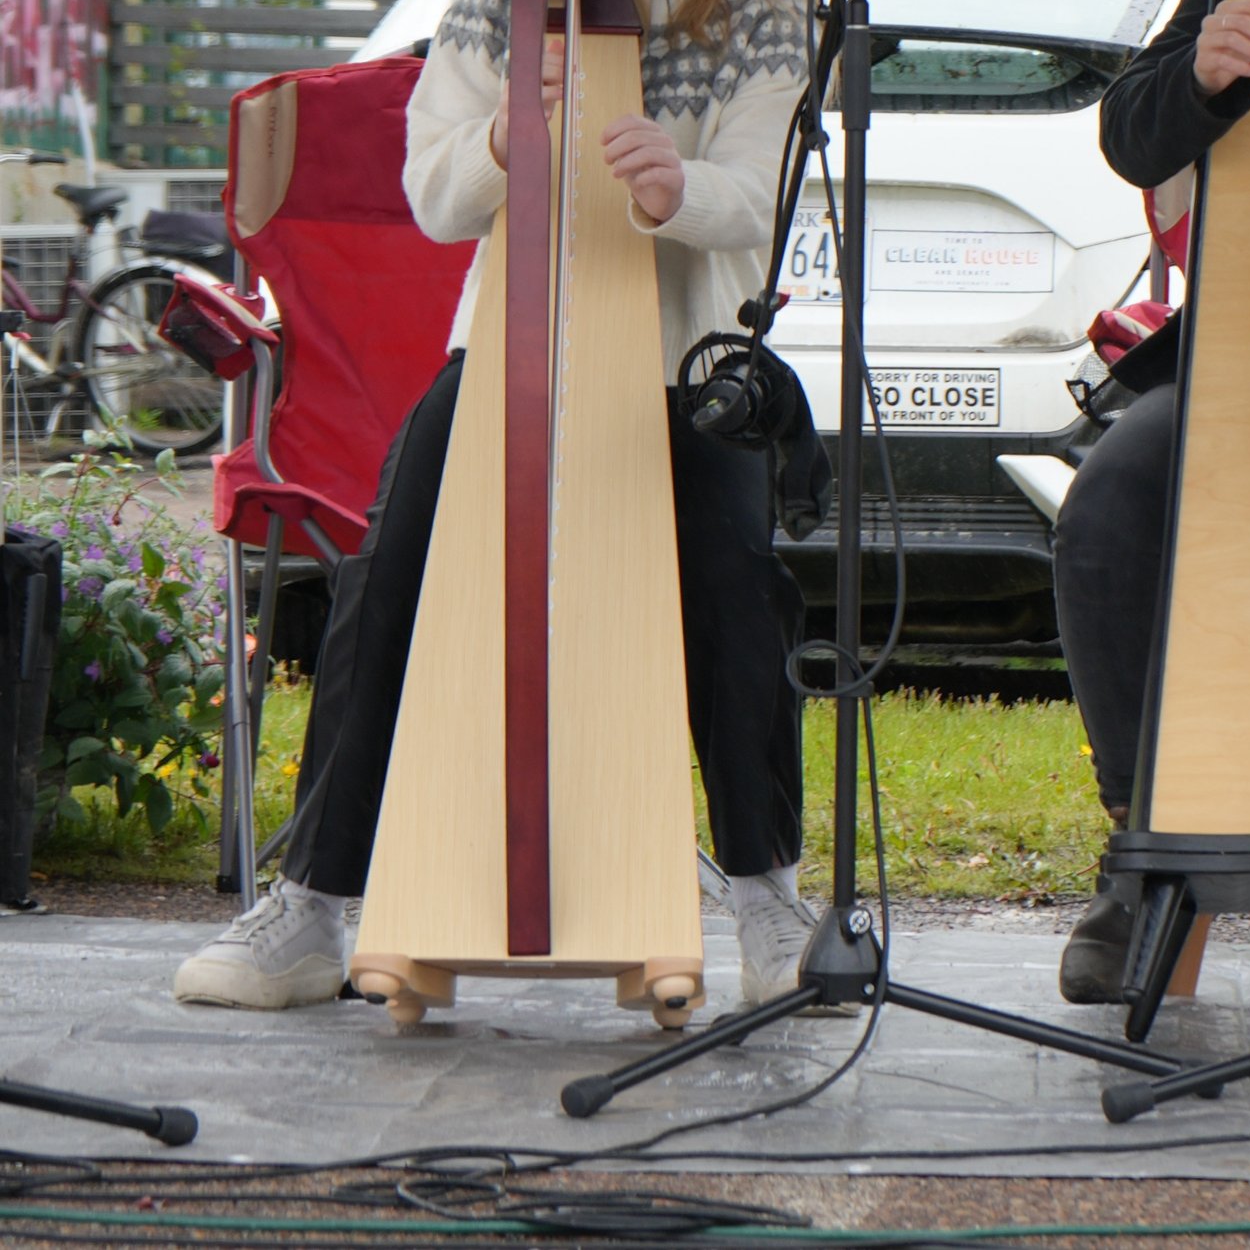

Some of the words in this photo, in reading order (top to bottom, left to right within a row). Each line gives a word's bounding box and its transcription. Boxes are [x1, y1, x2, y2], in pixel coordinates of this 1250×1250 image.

[791, 232, 840, 279] 64
[870, 372, 910, 383] SORRY
[914, 372, 940, 383] FOR
[944, 373, 996, 384] DRIVING
[869, 386, 900, 406] SO
[911, 386, 995, 407] CLOSE
[893, 411, 936, 421] FRONT
[939, 411, 956, 421] OF
[960, 411, 987, 421] YOU
